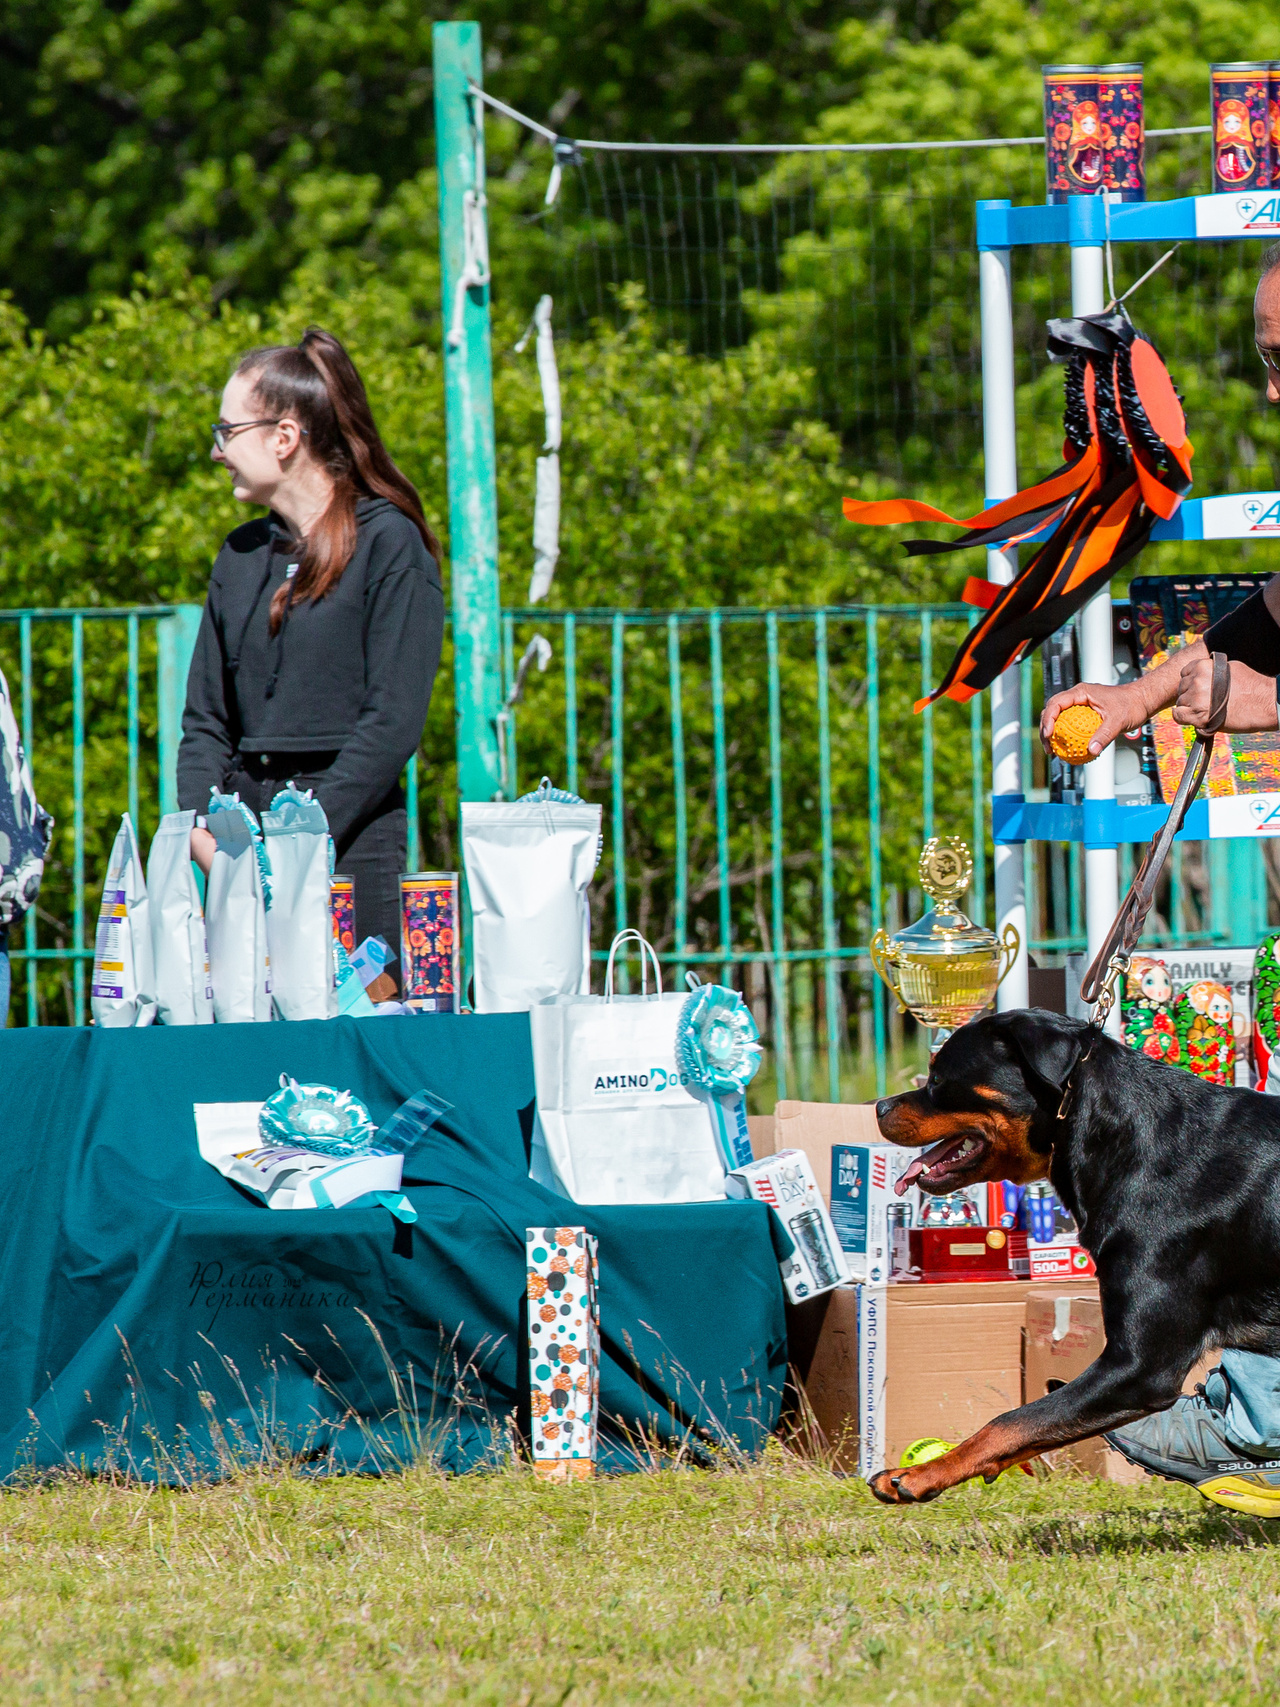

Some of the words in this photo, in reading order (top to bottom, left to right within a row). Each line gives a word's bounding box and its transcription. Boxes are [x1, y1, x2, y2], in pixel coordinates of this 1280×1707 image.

[1033, 1251, 1068, 1260] CAPACITY
[867, 1298, 877, 1337] УФПС
[867, 1341, 877, 1412] Псковской
[866, 1415, 876, 1469] области
